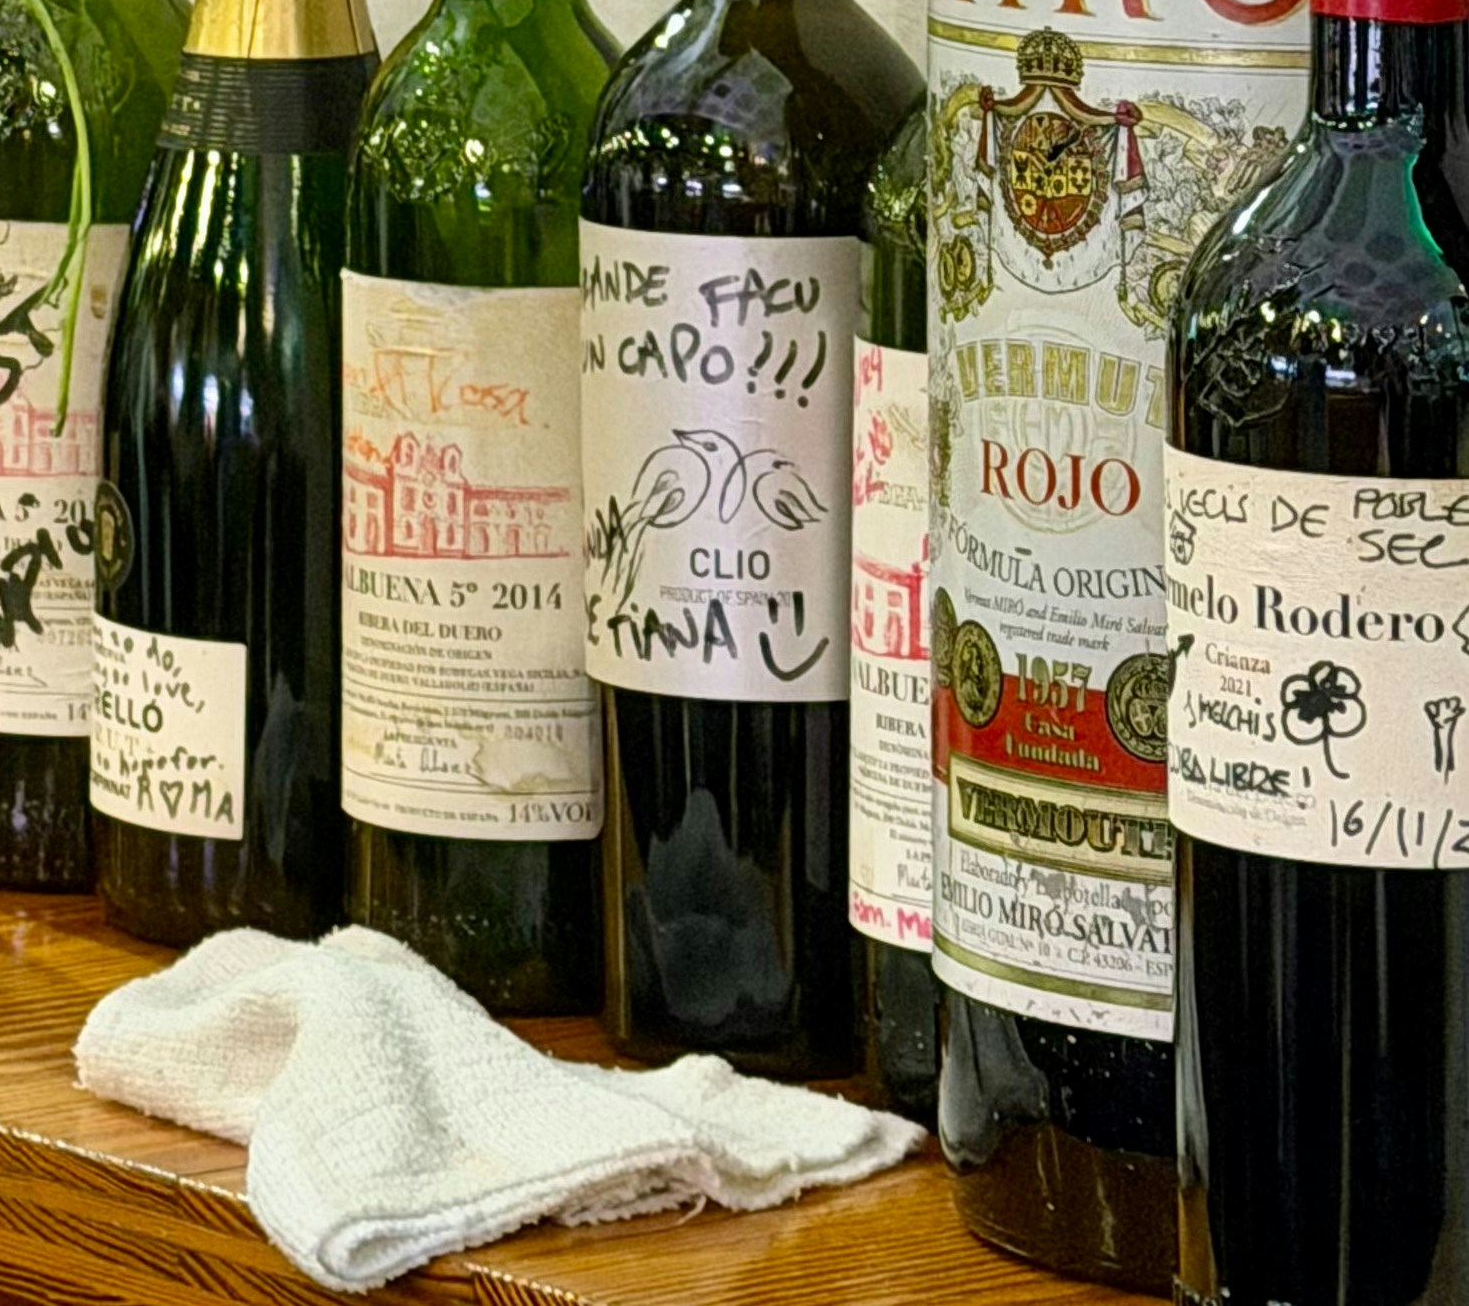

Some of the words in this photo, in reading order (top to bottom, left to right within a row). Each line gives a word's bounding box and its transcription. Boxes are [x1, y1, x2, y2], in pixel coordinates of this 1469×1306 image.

[698, 268, 822, 328] FACU
[980, 437, 1142, 517] ROJO
[1271, 494, 1330, 538] DE
[689, 547, 771, 580] CLIO
[947, 513, 1047, 595] FÓRMULA
[1357, 528, 1469, 569] SEC
[491, 582, 562, 610] 2014
[1253, 583, 1445, 643] Rodero
[402, 618, 435, 637] DEL
[438, 623, 503, 643] DUERO
[1204, 641, 1272, 675] Crianza
[1014, 651, 1093, 714] 1957
[1219, 674, 1252, 697] 2021
[941, 871, 993, 920] EMILIO
